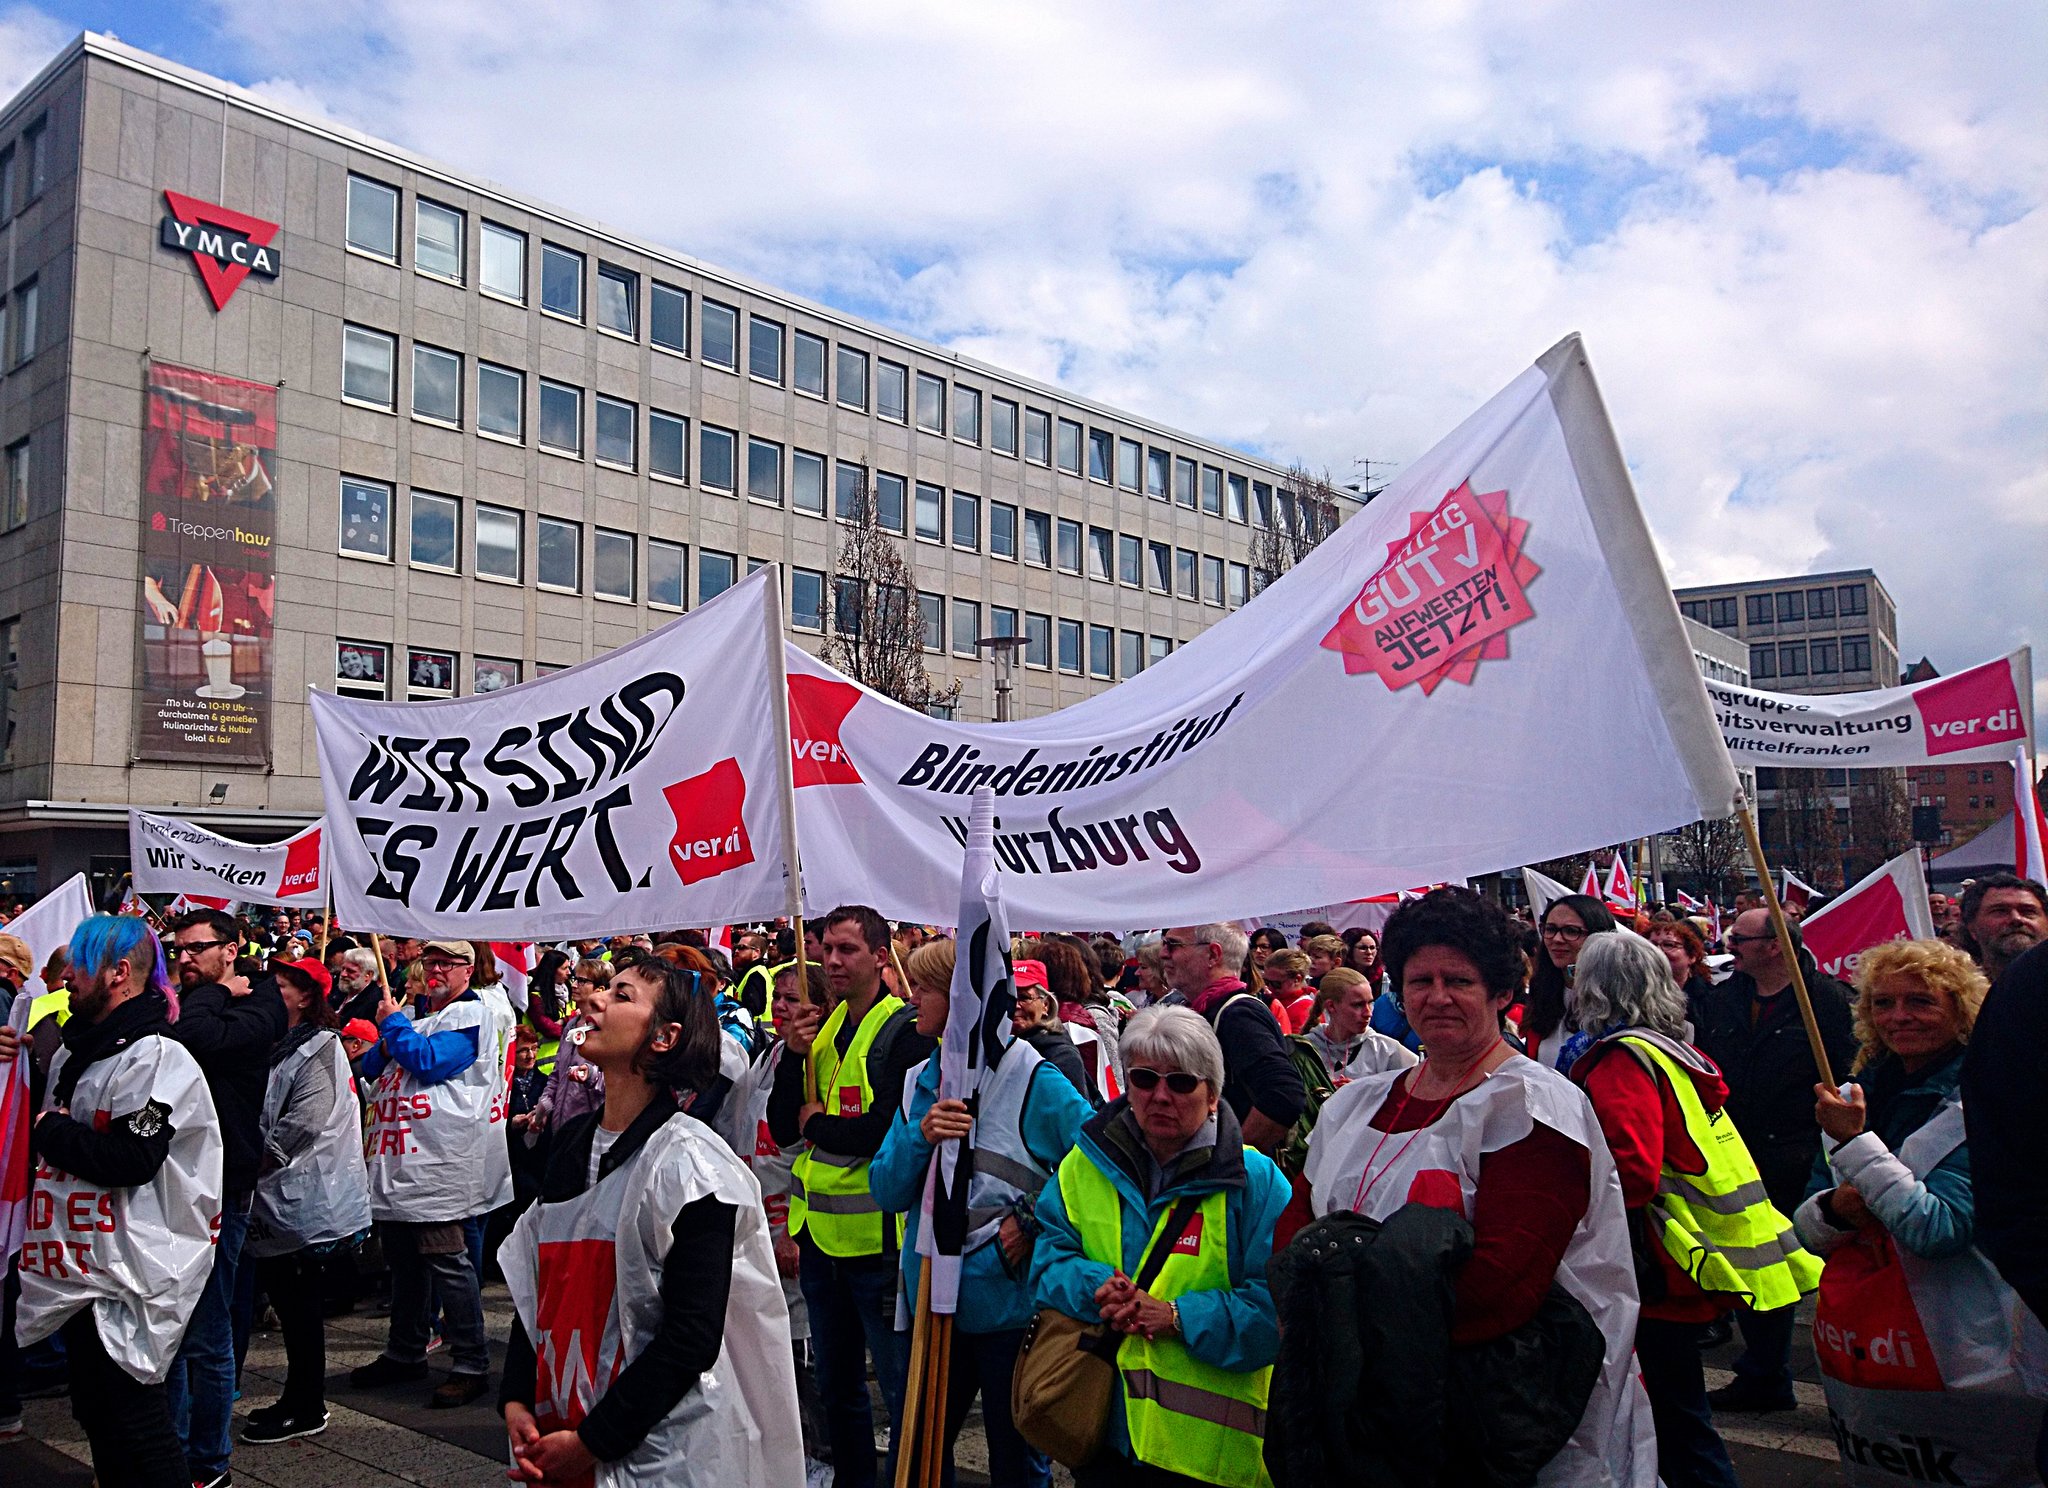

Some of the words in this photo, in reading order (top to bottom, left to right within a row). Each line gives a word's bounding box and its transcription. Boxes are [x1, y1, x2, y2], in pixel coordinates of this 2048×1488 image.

[173, 222, 272, 271] YMCA
[169, 517, 271, 546] Treppenhaus
[1354, 544, 1446, 626] GUT
[1374, 563, 1499, 648] AUFWERTEN
[1381, 580, 1512, 672] JETZT!
[158, 709, 209, 720] durchatmen
[211, 713, 218, 721] &
[220, 715, 257, 724] genießen
[165, 698, 181, 707] Mo
[182, 699, 194, 708] bis
[196, 700, 207, 709] Sa
[208, 701, 230, 711] 10-19
[232, 702, 246, 712] Uhr
[1929, 709, 2019, 738] ver.di
[163, 721, 218, 732] Kulinarisches
[220, 724, 226, 733] &
[228, 725, 253, 734] Kultur
[208, 734, 215, 743] &
[217, 735, 232, 744] fair
[347, 732, 490, 813] WIR
[483, 671, 687, 808] SIND
[898, 692, 1246, 797] Blindeninstitut
[145, 848, 186, 869] Wir
[354, 816, 439, 908] ES
[673, 826, 742, 864] ver.di
[285, 867, 317, 886] ver.di
[67, 1192, 116, 1233] ES
[1816, 1320, 1916, 1368] ver.di
